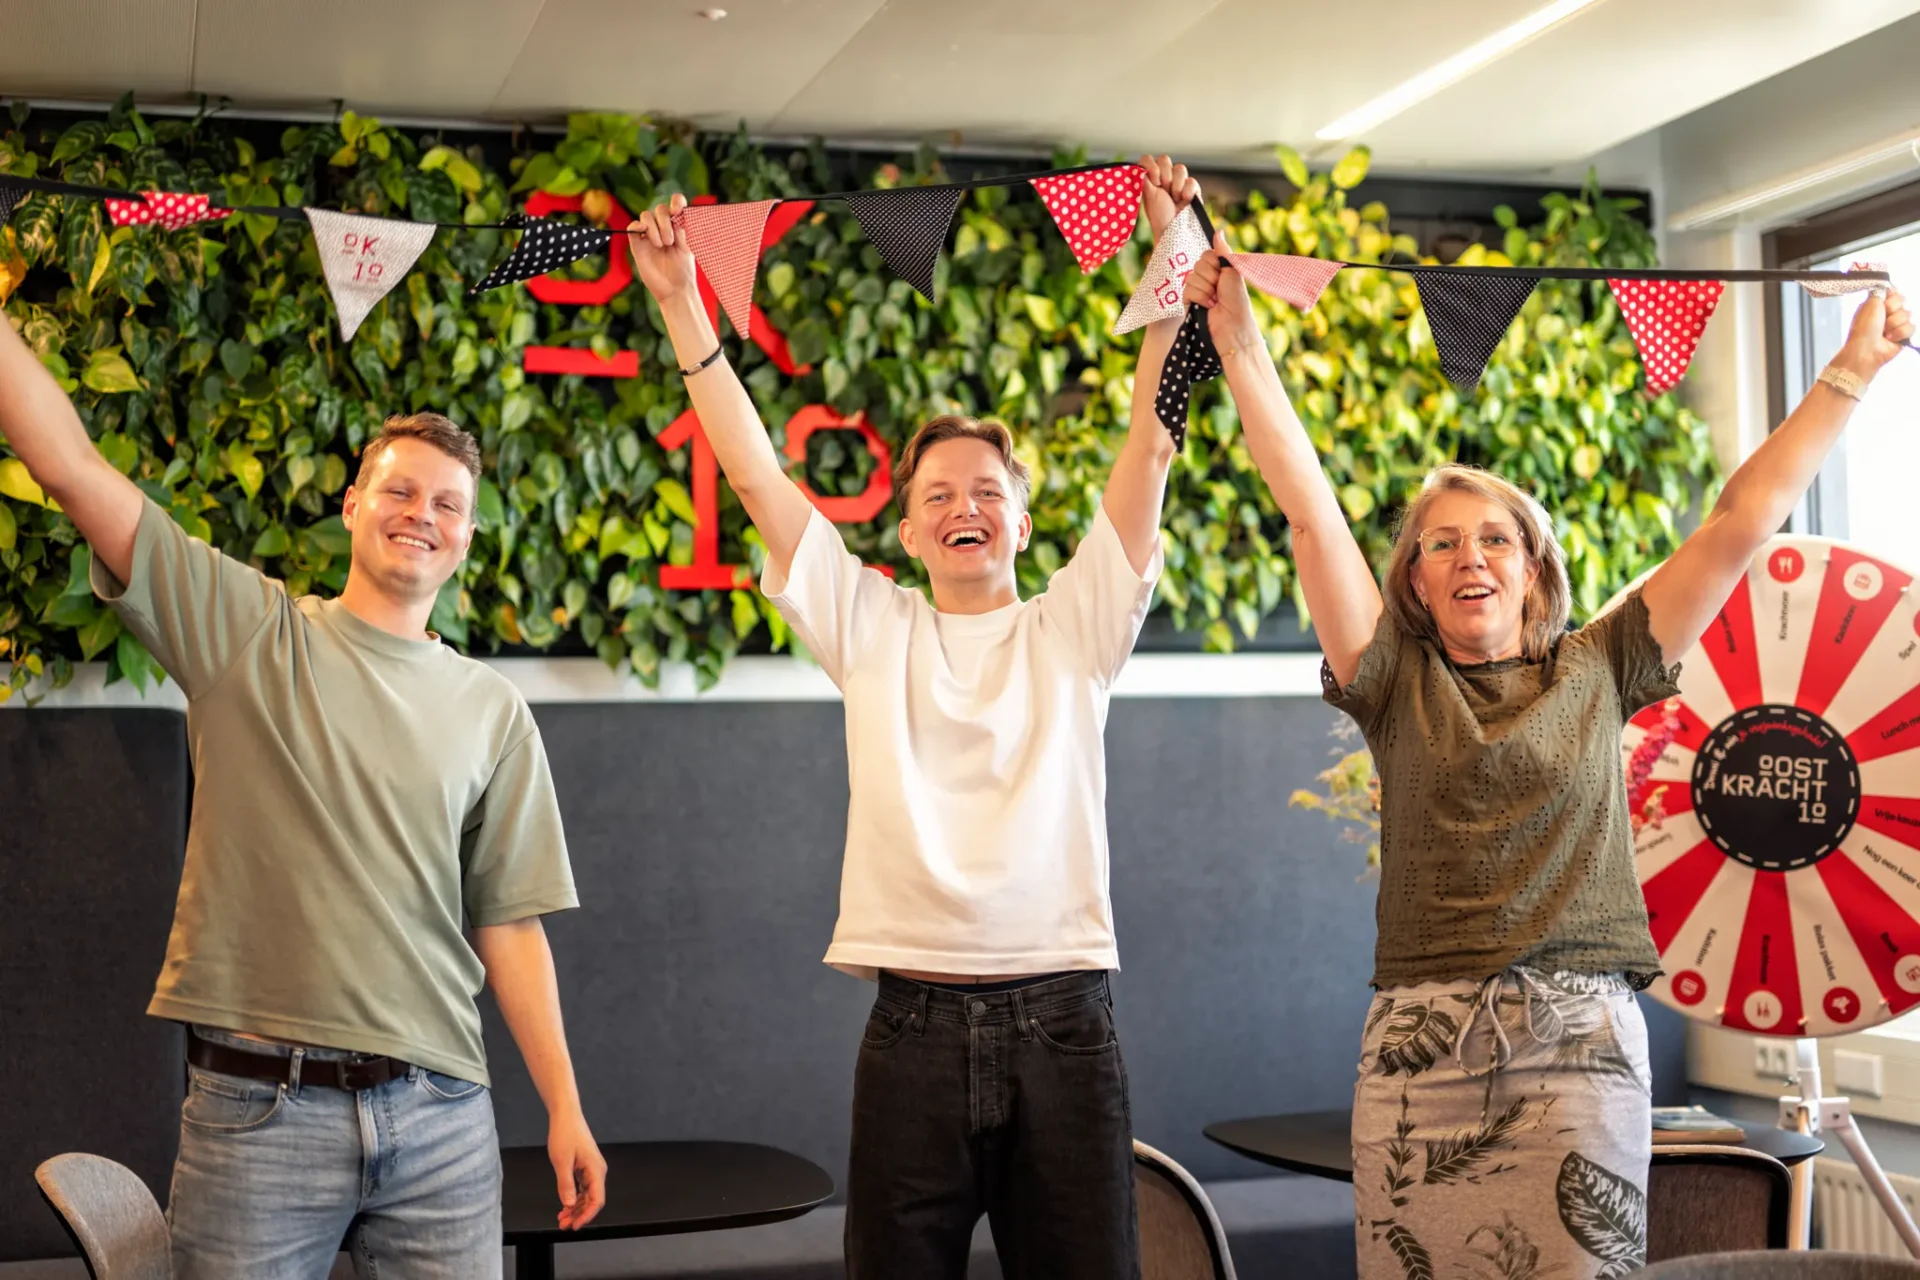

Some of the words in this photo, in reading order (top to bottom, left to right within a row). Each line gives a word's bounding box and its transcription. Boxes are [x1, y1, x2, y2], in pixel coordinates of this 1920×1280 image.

[340, 232, 380, 256] OK
[352, 261, 383, 283] 10
[1154, 278, 1179, 310] 10
[656, 403, 894, 591] 10
[1898, 640, 1917, 660] Spel
[1880, 721, 1909, 740] Lunch
[1758, 755, 1828, 780] OOST
[1721, 773, 1828, 802] KRACHT
[1798, 802, 1827, 824] 10
[1862, 844, 1882, 863] Nog
[1881, 858, 1898, 873] een
[1897, 867, 1917, 884] keer
